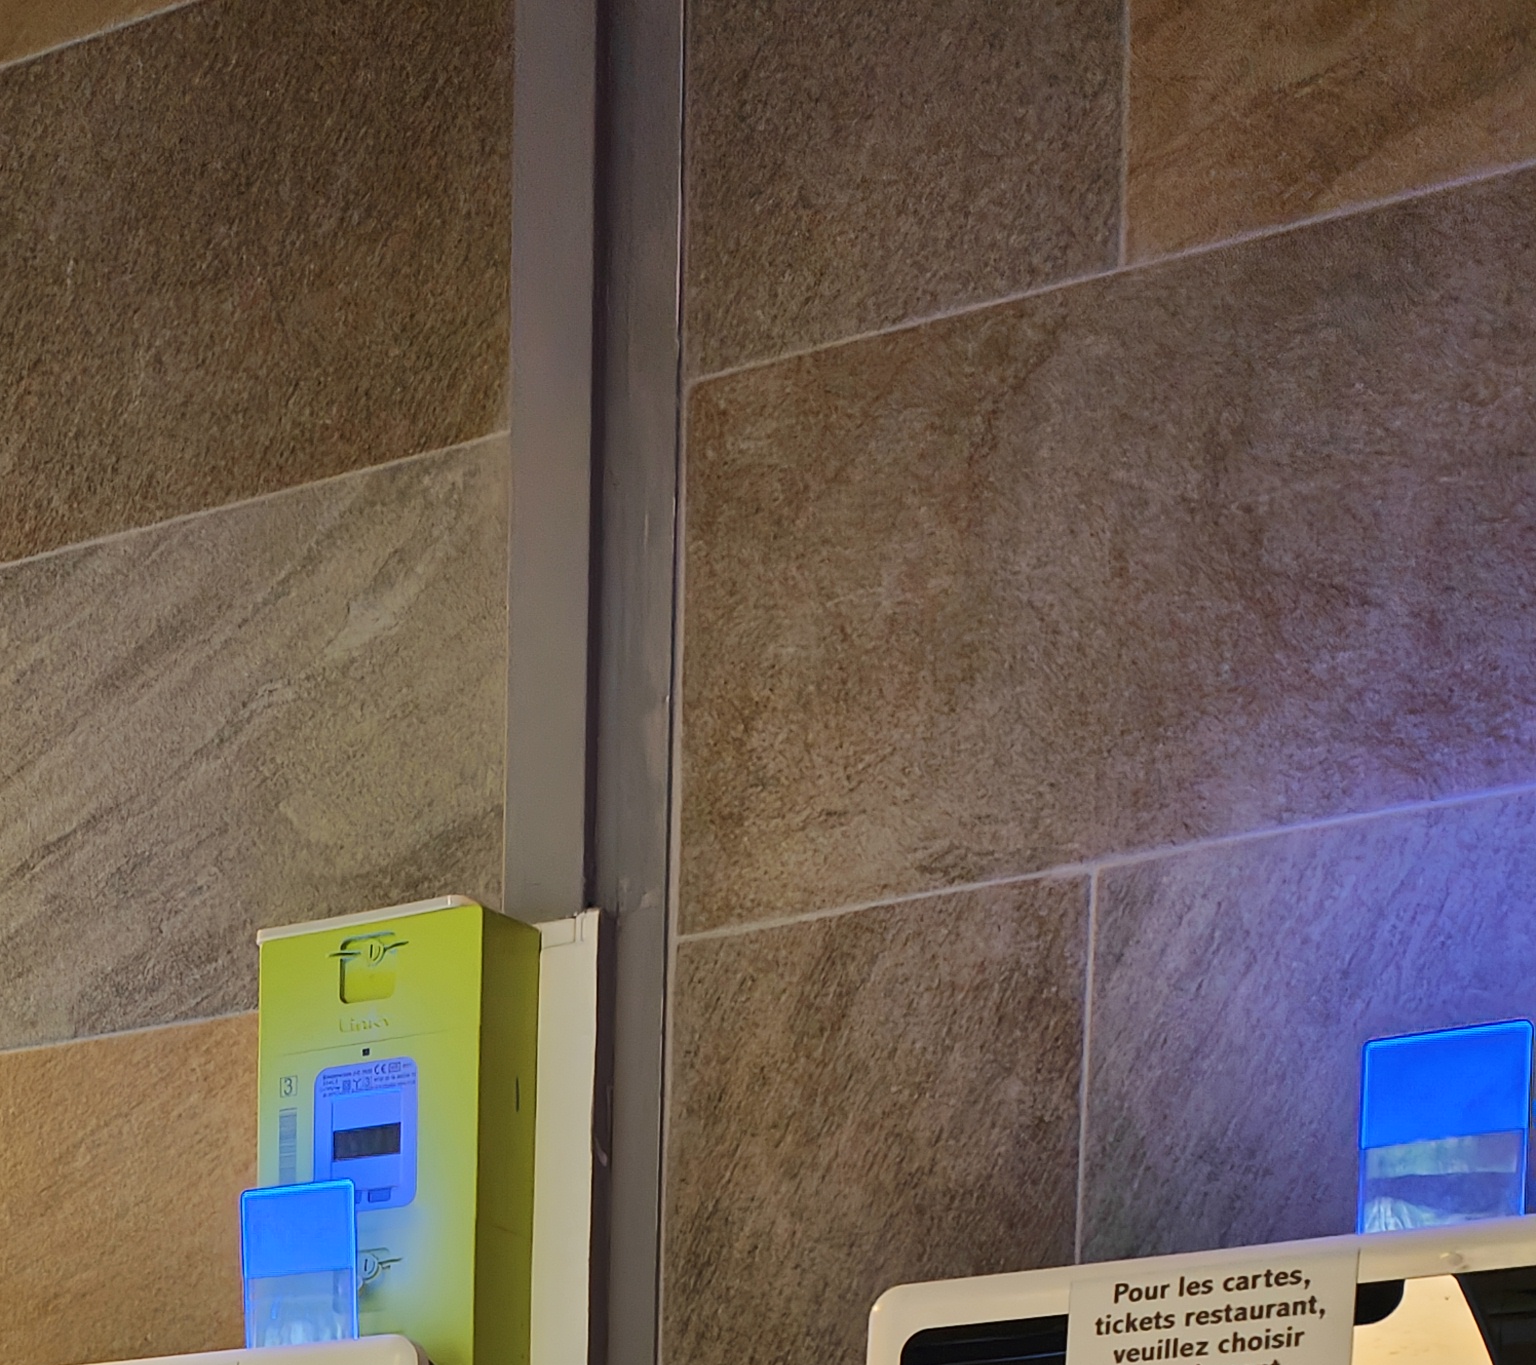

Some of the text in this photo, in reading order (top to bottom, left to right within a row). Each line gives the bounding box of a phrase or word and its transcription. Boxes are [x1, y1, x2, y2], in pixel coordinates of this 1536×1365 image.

[1114, 1269, 1311, 1304] Pour les cartes,
[1095, 1296, 1325, 1335] tickets restaurant,
[1114, 1326, 1305, 1363] veuillez choisir
